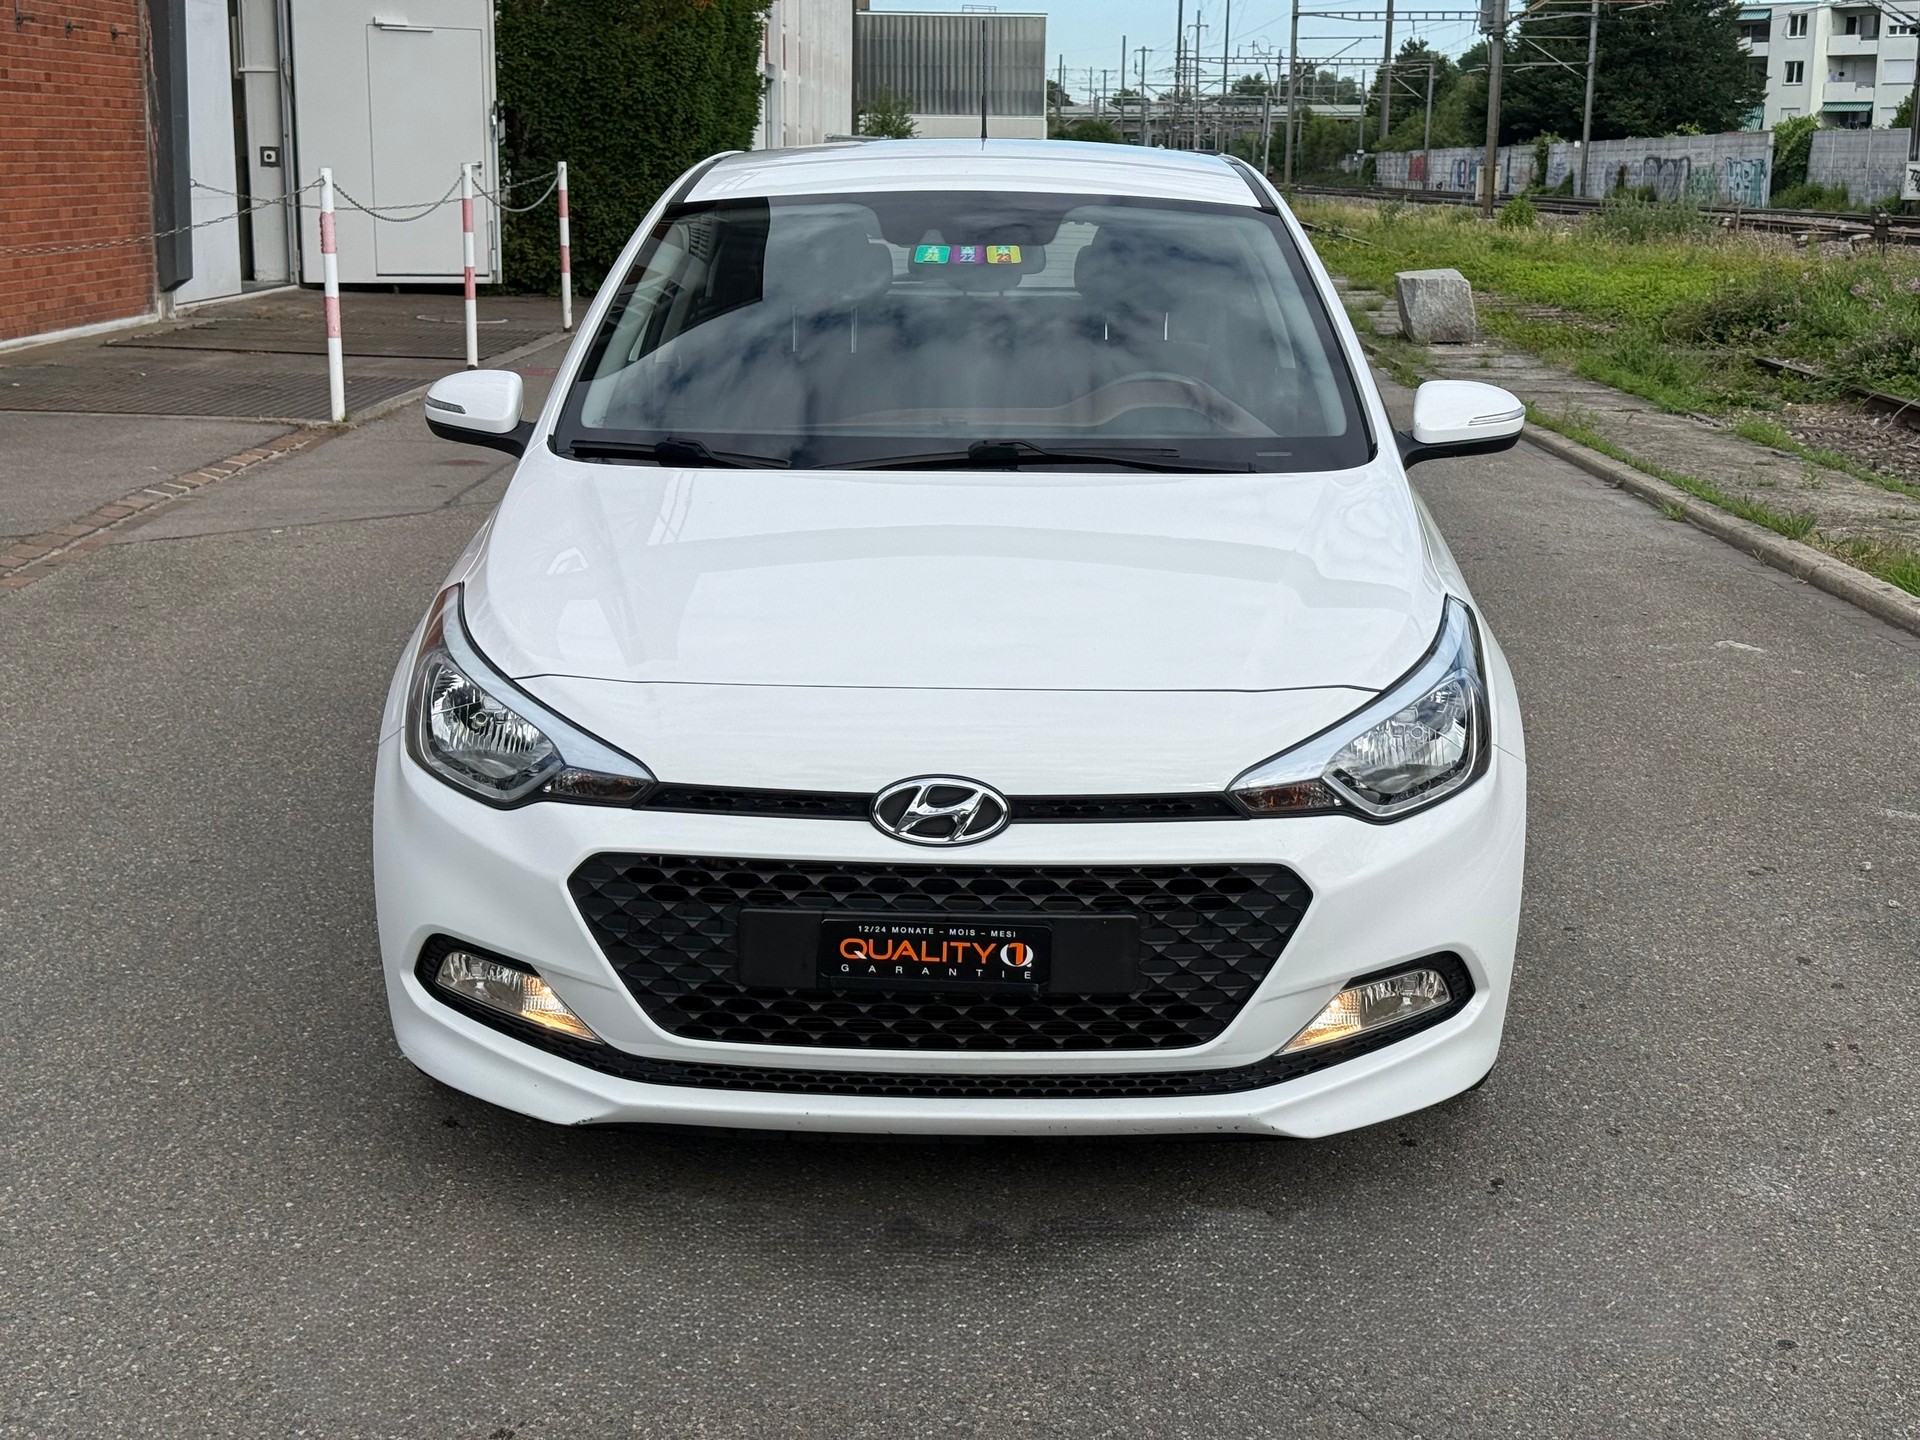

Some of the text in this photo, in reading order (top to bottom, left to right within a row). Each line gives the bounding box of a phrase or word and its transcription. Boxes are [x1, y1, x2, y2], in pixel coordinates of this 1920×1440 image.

[959, 254, 976, 262] 22
[858, 925, 887, 933] 12/24
[891, 926, 934, 935] MONATE
[949, 928, 976, 937] MOIS
[990, 930, 1016, 938] MESI
[839, 938, 997, 964] QUALITY
[840, 963, 1032, 979] GARANTIE
